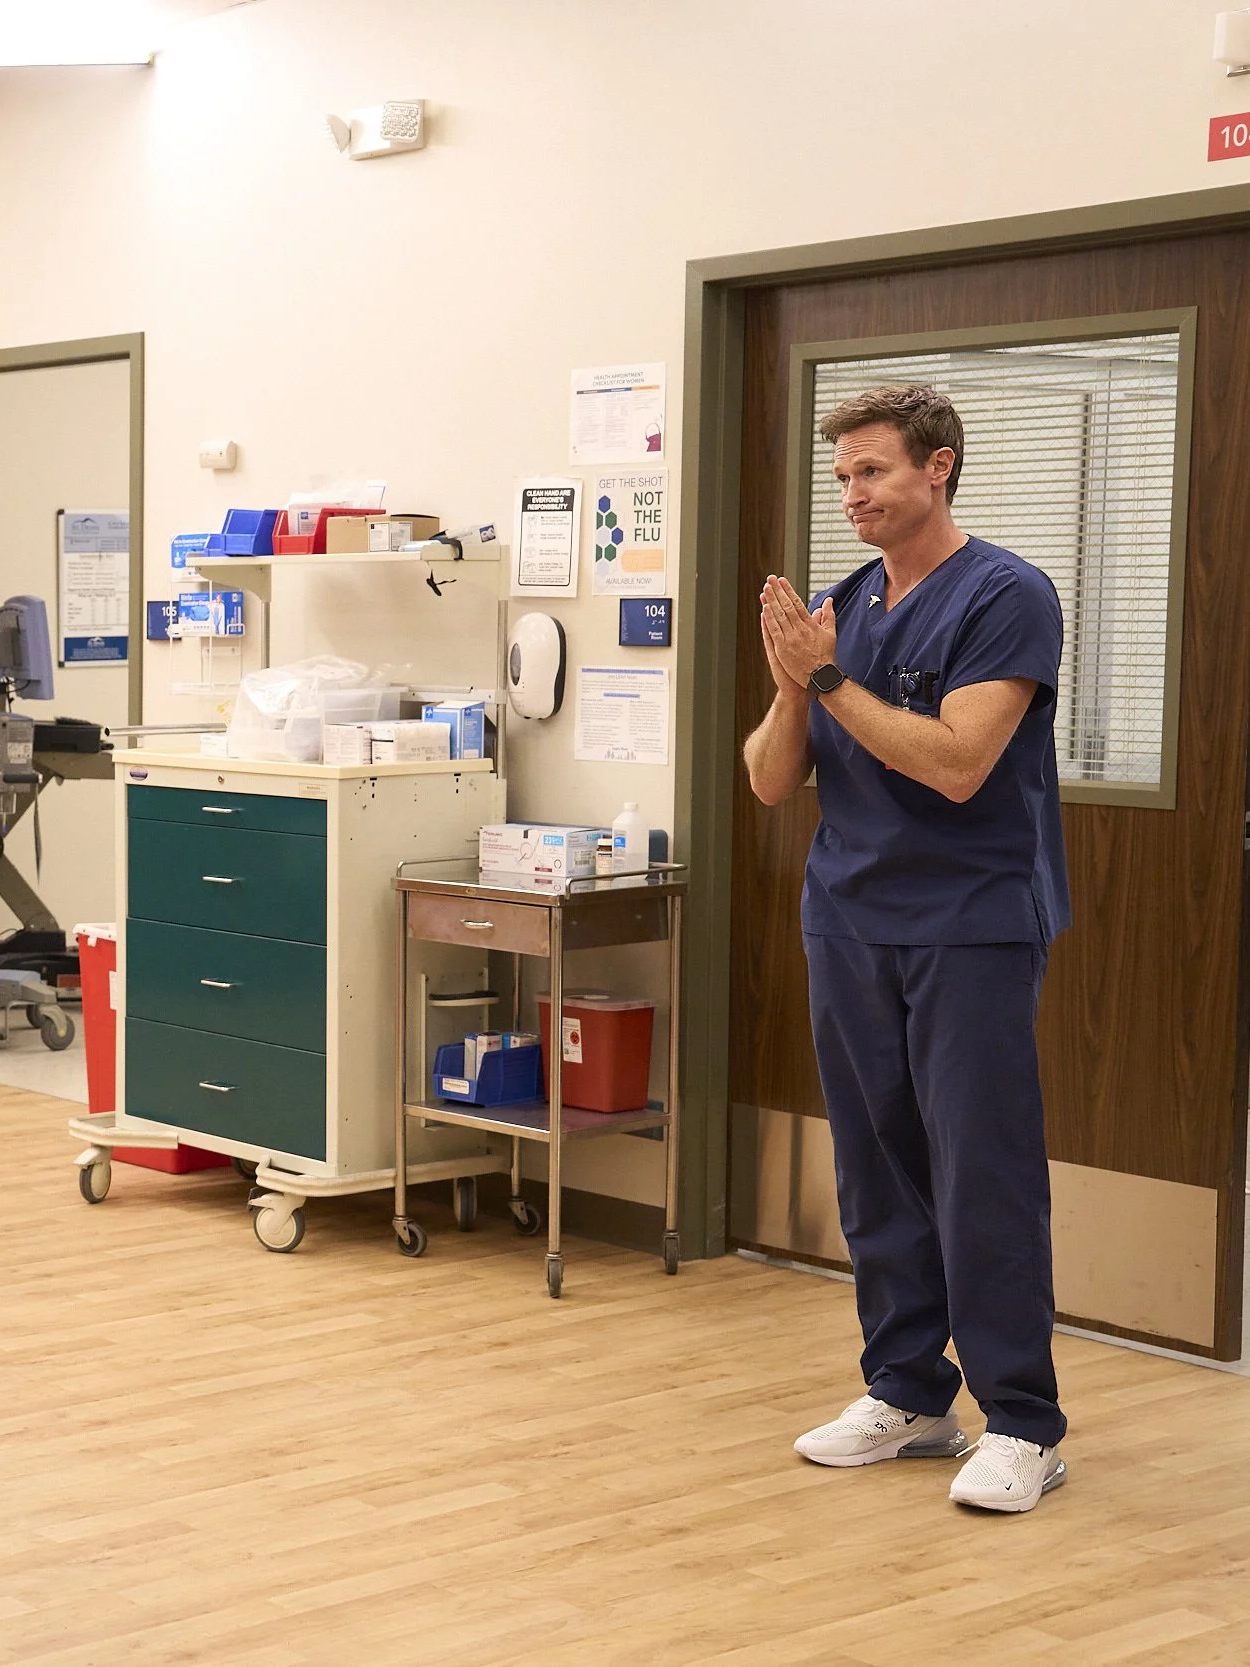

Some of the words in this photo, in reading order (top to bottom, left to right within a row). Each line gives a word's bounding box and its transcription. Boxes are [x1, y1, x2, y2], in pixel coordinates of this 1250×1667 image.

[1221, 123, 1250, 149] 10
[599, 479, 616, 489] GET
[619, 478, 636, 488] THE
[638, 476, 663, 488] SHOT
[633, 491, 663, 506] NOT
[633, 509, 661, 524] THE
[634, 527, 660, 542] FLU
[644, 605, 666, 617] 104
